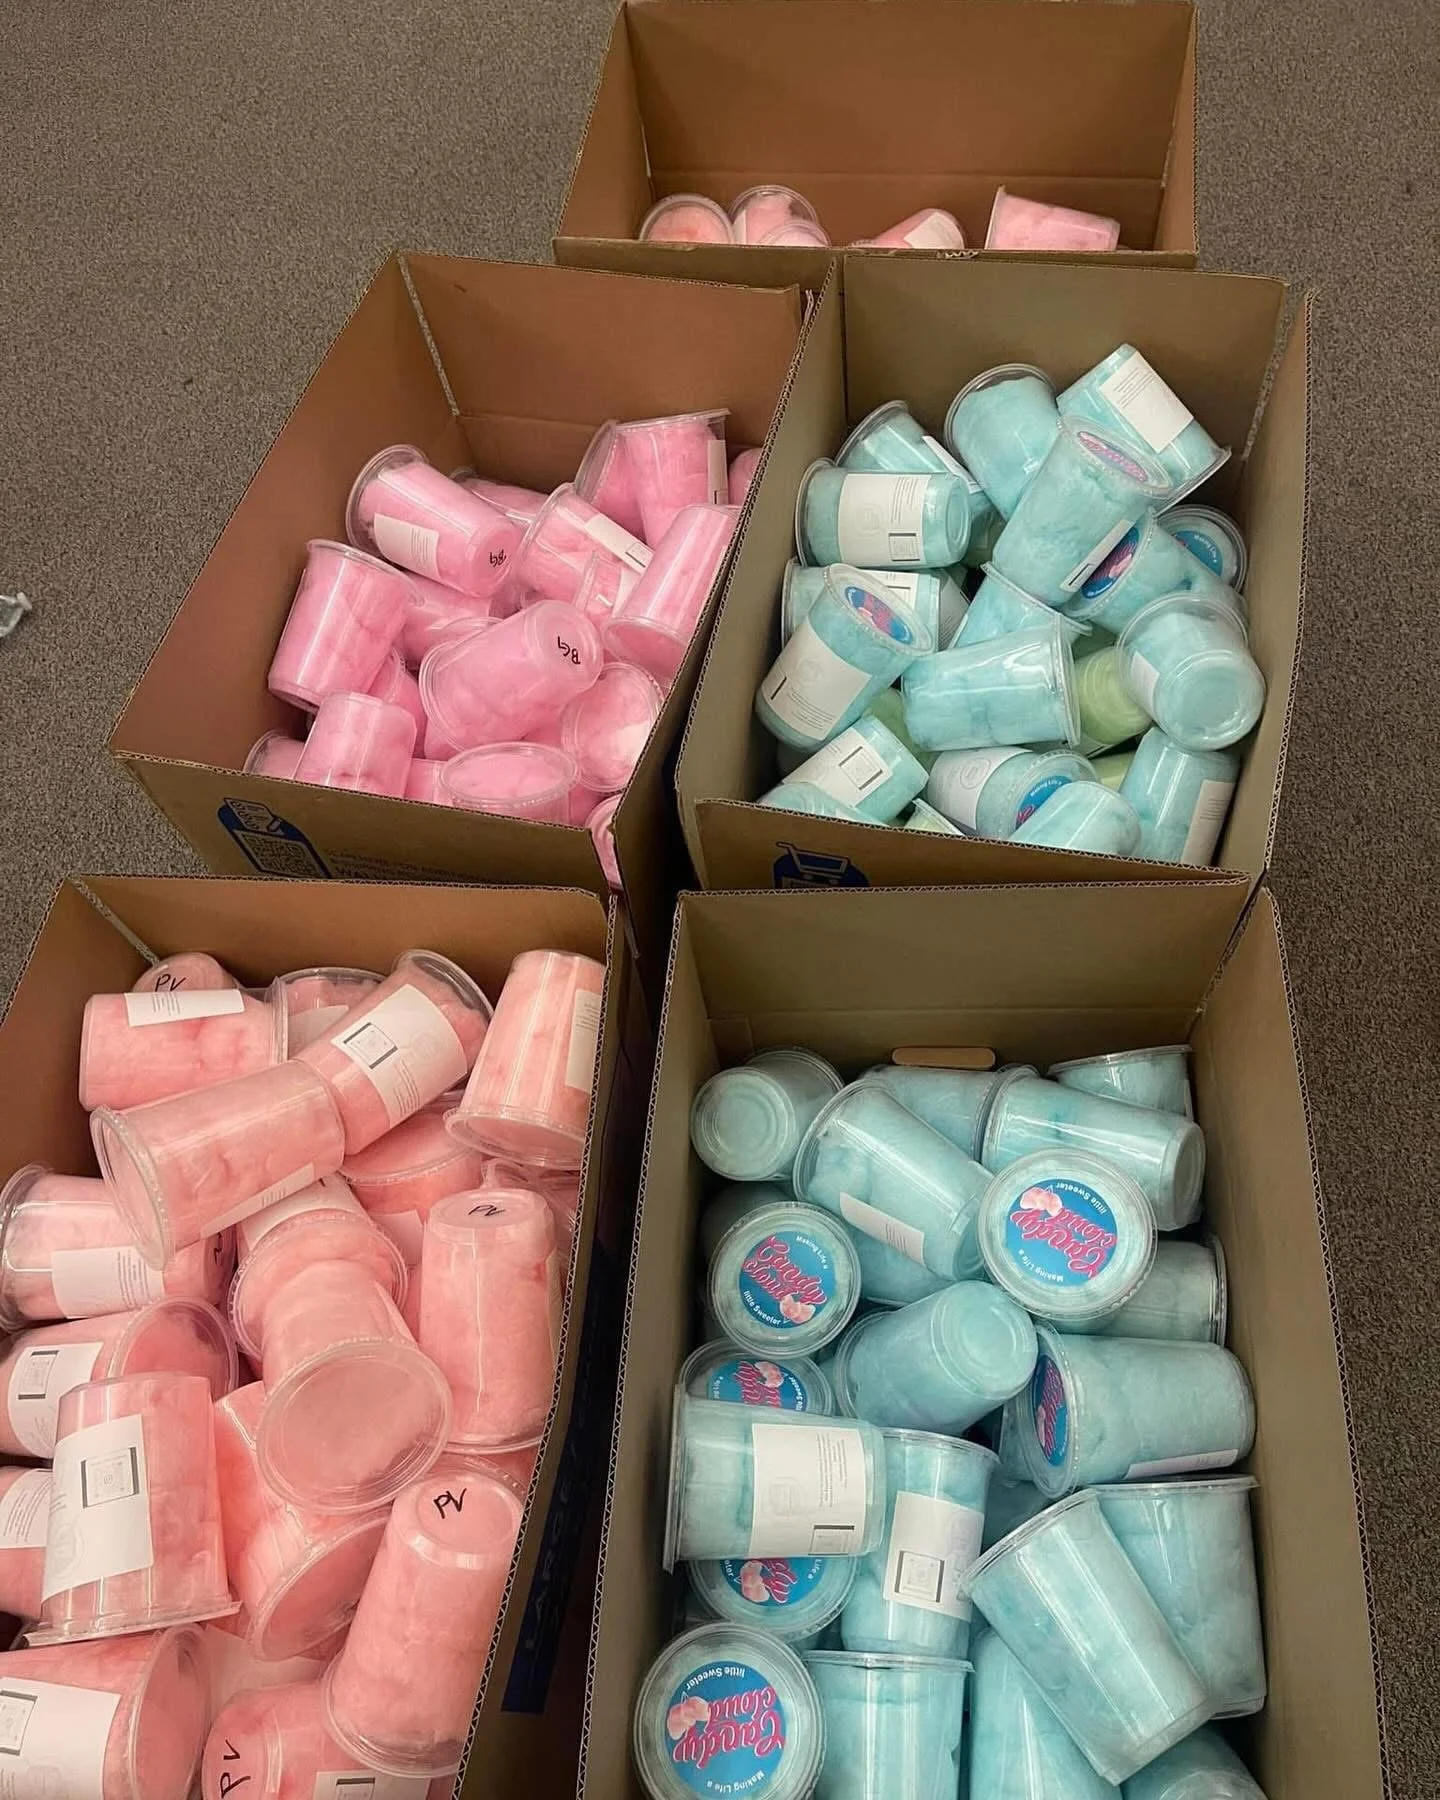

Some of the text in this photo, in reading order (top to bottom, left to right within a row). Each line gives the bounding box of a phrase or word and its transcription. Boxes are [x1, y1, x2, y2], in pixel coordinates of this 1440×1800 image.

[154, 973, 187, 992] PV
[1056, 1182, 1091, 1201] Sweeter
[1010, 1208, 1106, 1278] Candy
[757, 1235, 828, 1305] Candy
[1036, 1267, 1064, 1283] Making
[753, 1304, 782, 1325] Sweeter
[433, 1487, 467, 1519] PV
[686, 1666, 746, 1690] little Sweeter
[672, 1708, 786, 1770] Candy
[220, 1739, 251, 1799] PV
[734, 1769, 765, 1792] Making
[714, 1783, 732, 1794] Life
